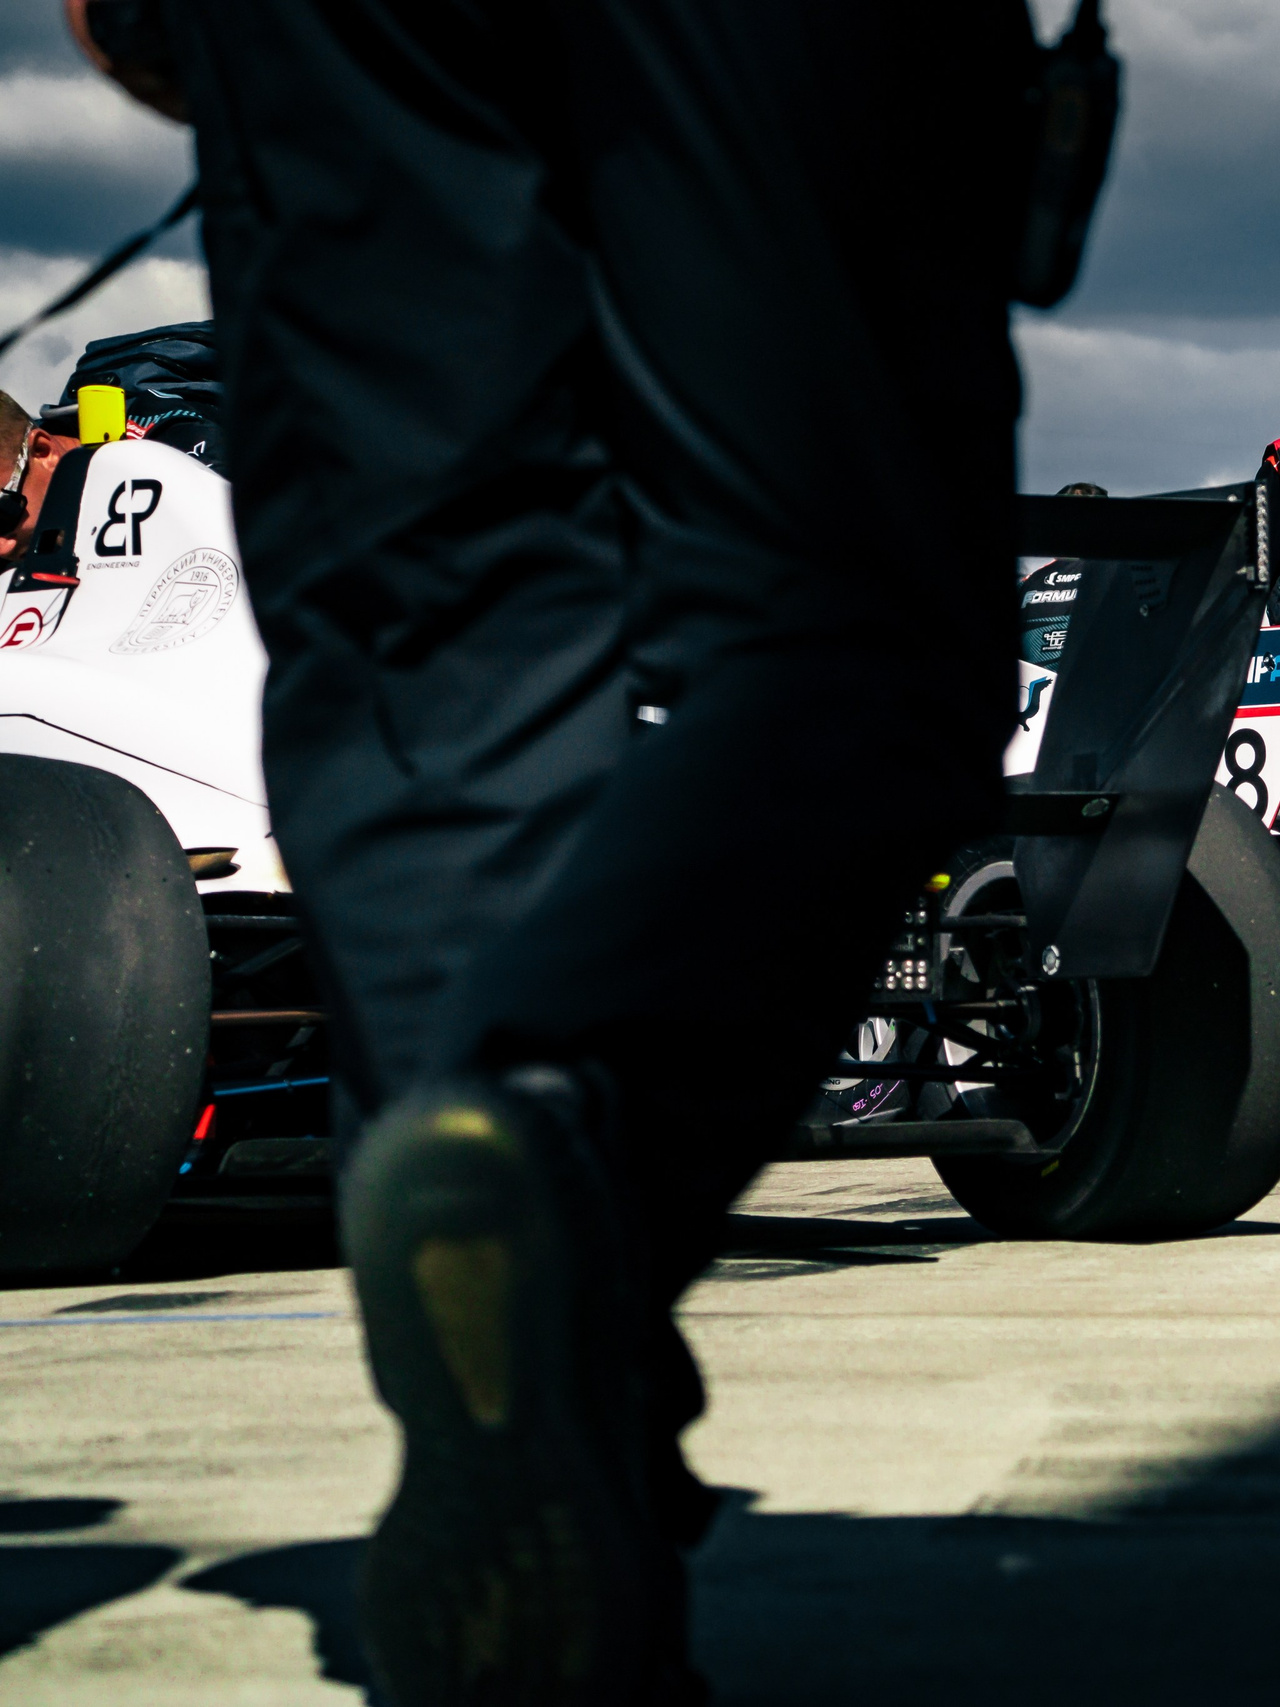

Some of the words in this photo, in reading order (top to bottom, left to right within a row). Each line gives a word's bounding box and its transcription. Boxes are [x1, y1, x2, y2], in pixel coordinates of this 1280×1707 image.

[86, 561, 140, 570] ENGINEERING
[190, 571, 208, 582] 1916
[139, 551, 197, 618] ПЕРМСКИЙ
[201, 551, 235, 622] УНИВЕРСИТЕТ
